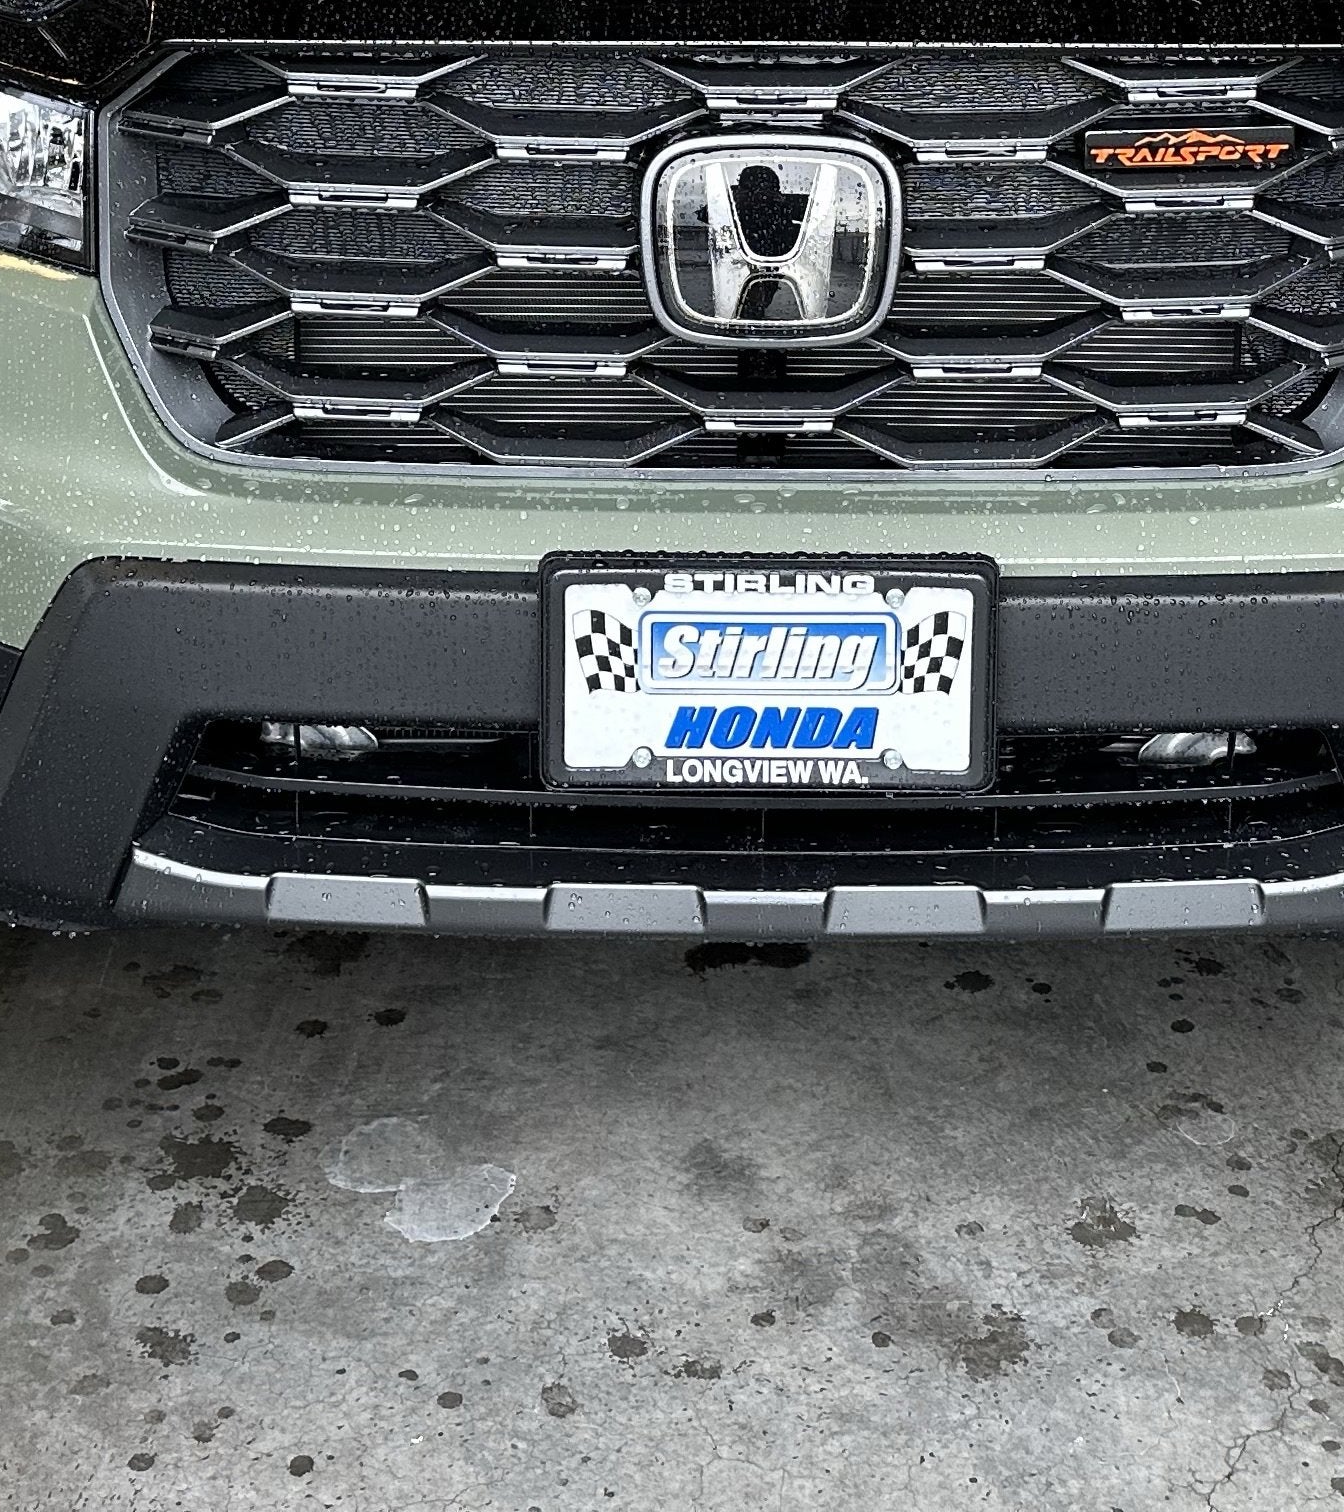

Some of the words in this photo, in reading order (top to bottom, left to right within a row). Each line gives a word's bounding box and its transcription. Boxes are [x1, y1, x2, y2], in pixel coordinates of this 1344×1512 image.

[1089, 144, 1290, 166] TRAILSPORT
[663, 572, 876, 594] STIRLING
[658, 623, 879, 690] Stirling
[664, 705, 880, 749] HONDA
[666, 759, 815, 783] LONGVIEW
